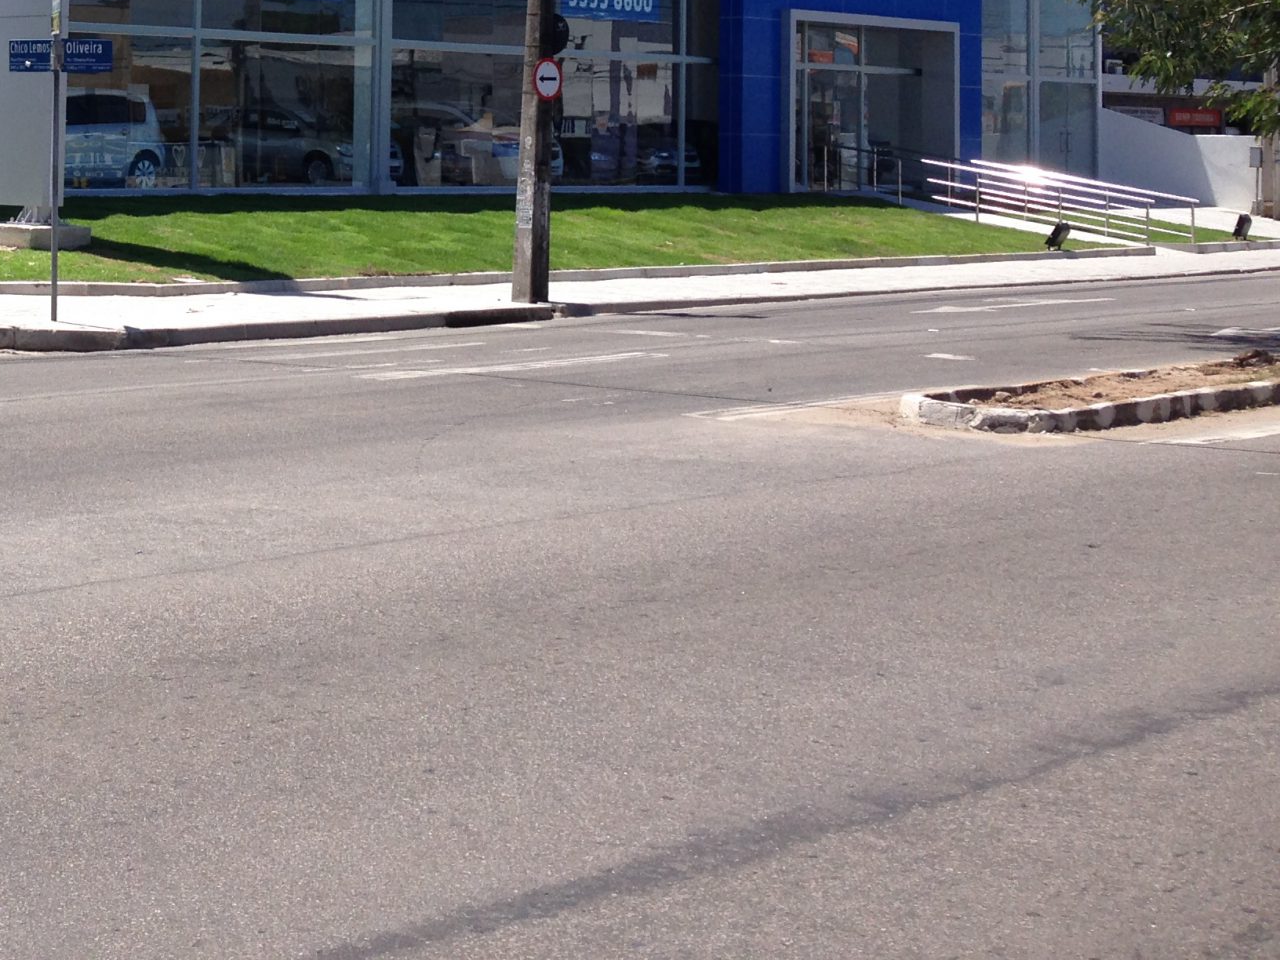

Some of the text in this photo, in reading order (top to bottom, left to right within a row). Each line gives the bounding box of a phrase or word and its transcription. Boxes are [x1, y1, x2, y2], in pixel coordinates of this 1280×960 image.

[10, 42, 50, 53] Chico Lemos
[66, 42, 102, 53] Oliveira
